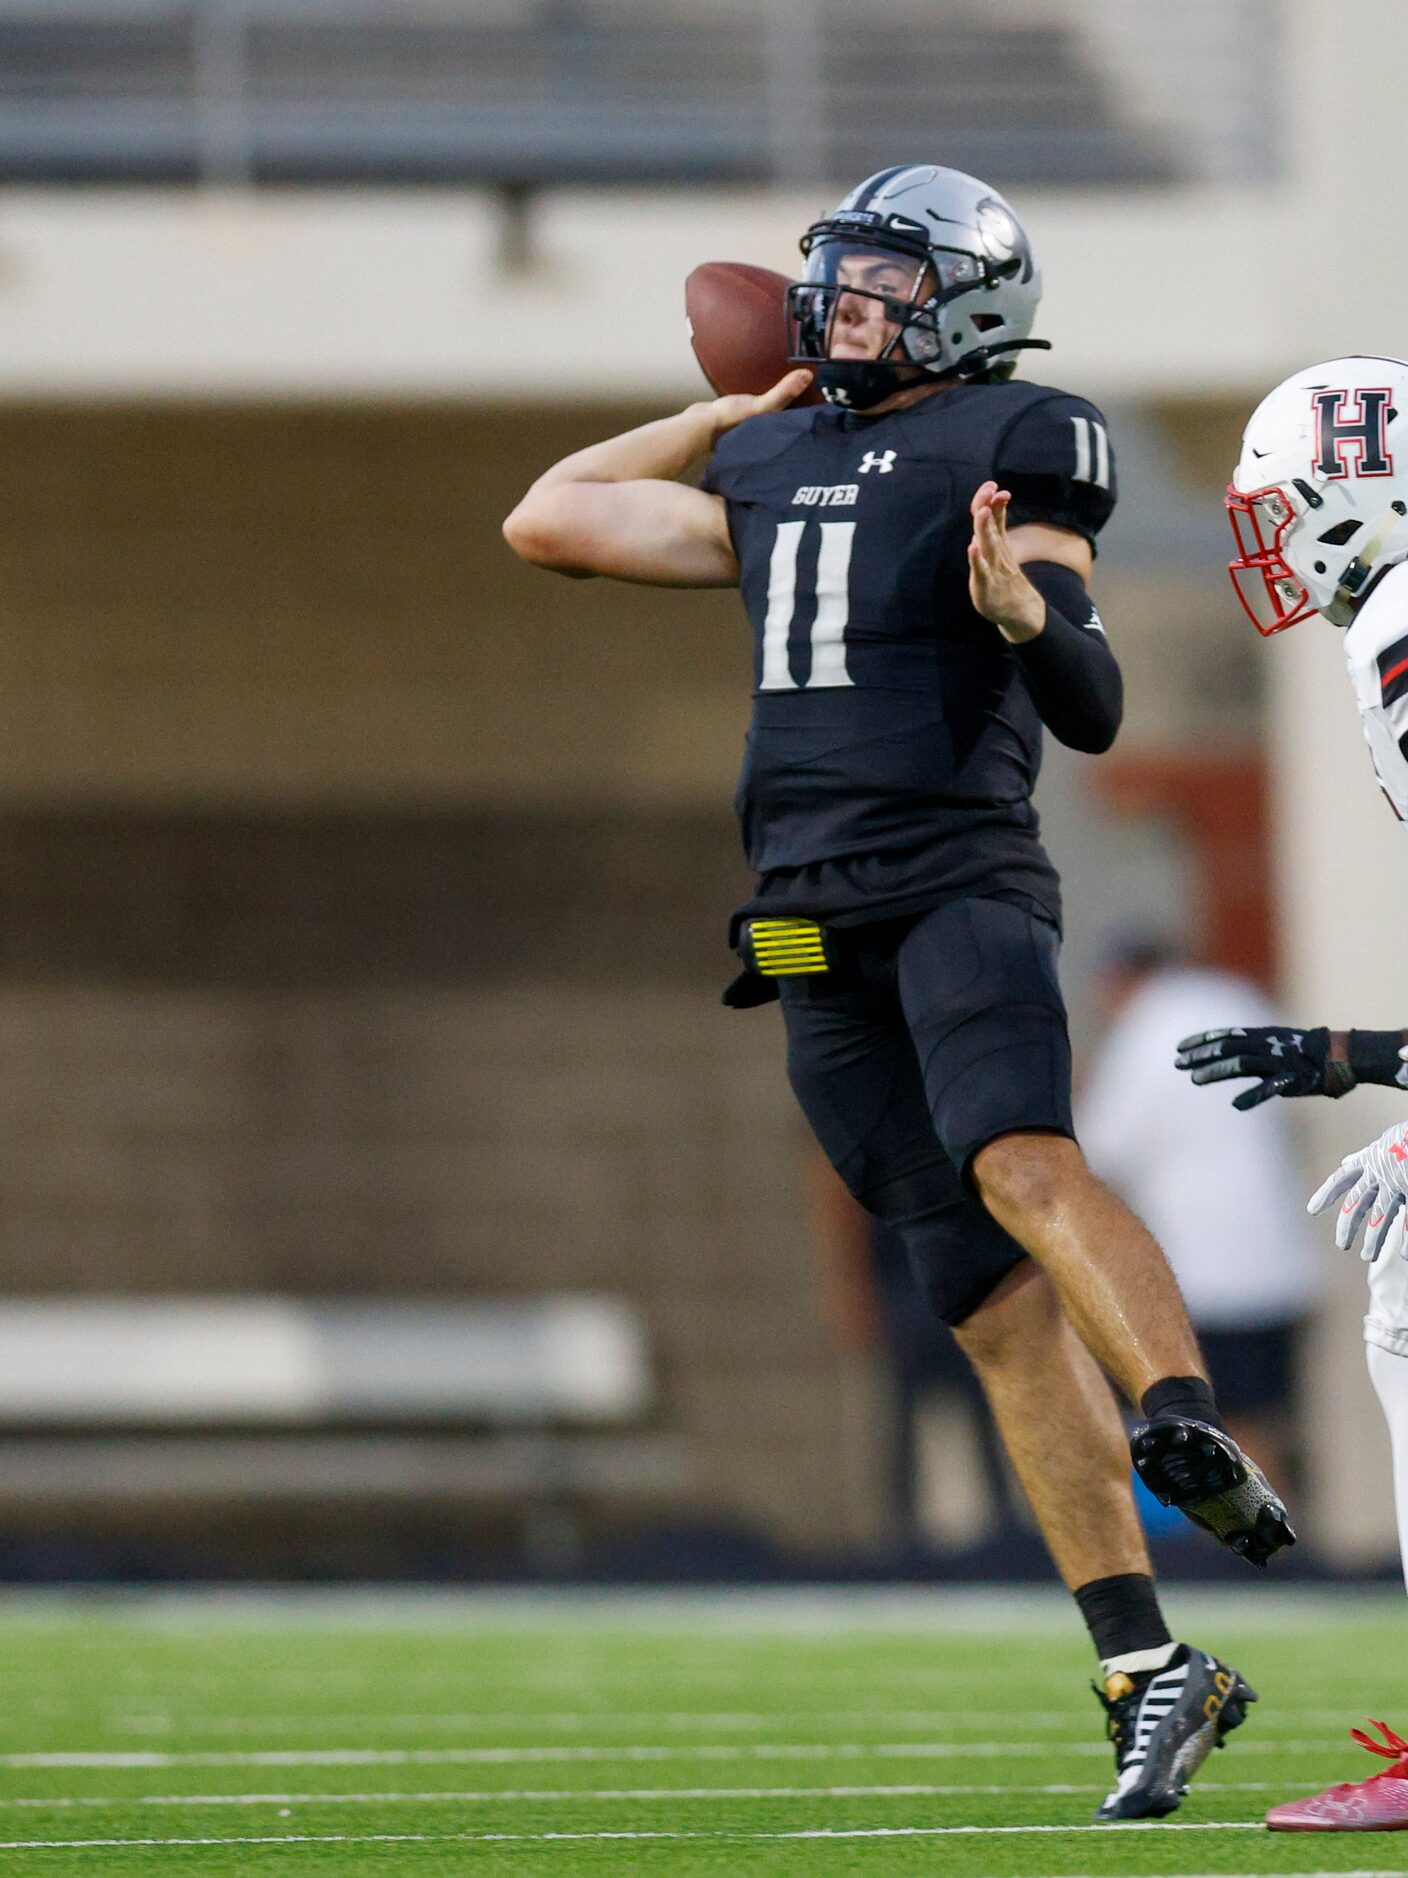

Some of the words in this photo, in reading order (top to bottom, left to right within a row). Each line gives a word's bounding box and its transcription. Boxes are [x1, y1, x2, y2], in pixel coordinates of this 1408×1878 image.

[1069, 416, 1109, 489] 11
[1312, 387, 1393, 481] H
[789, 484, 859, 507] GUYER
[759, 521, 857, 689] 11
